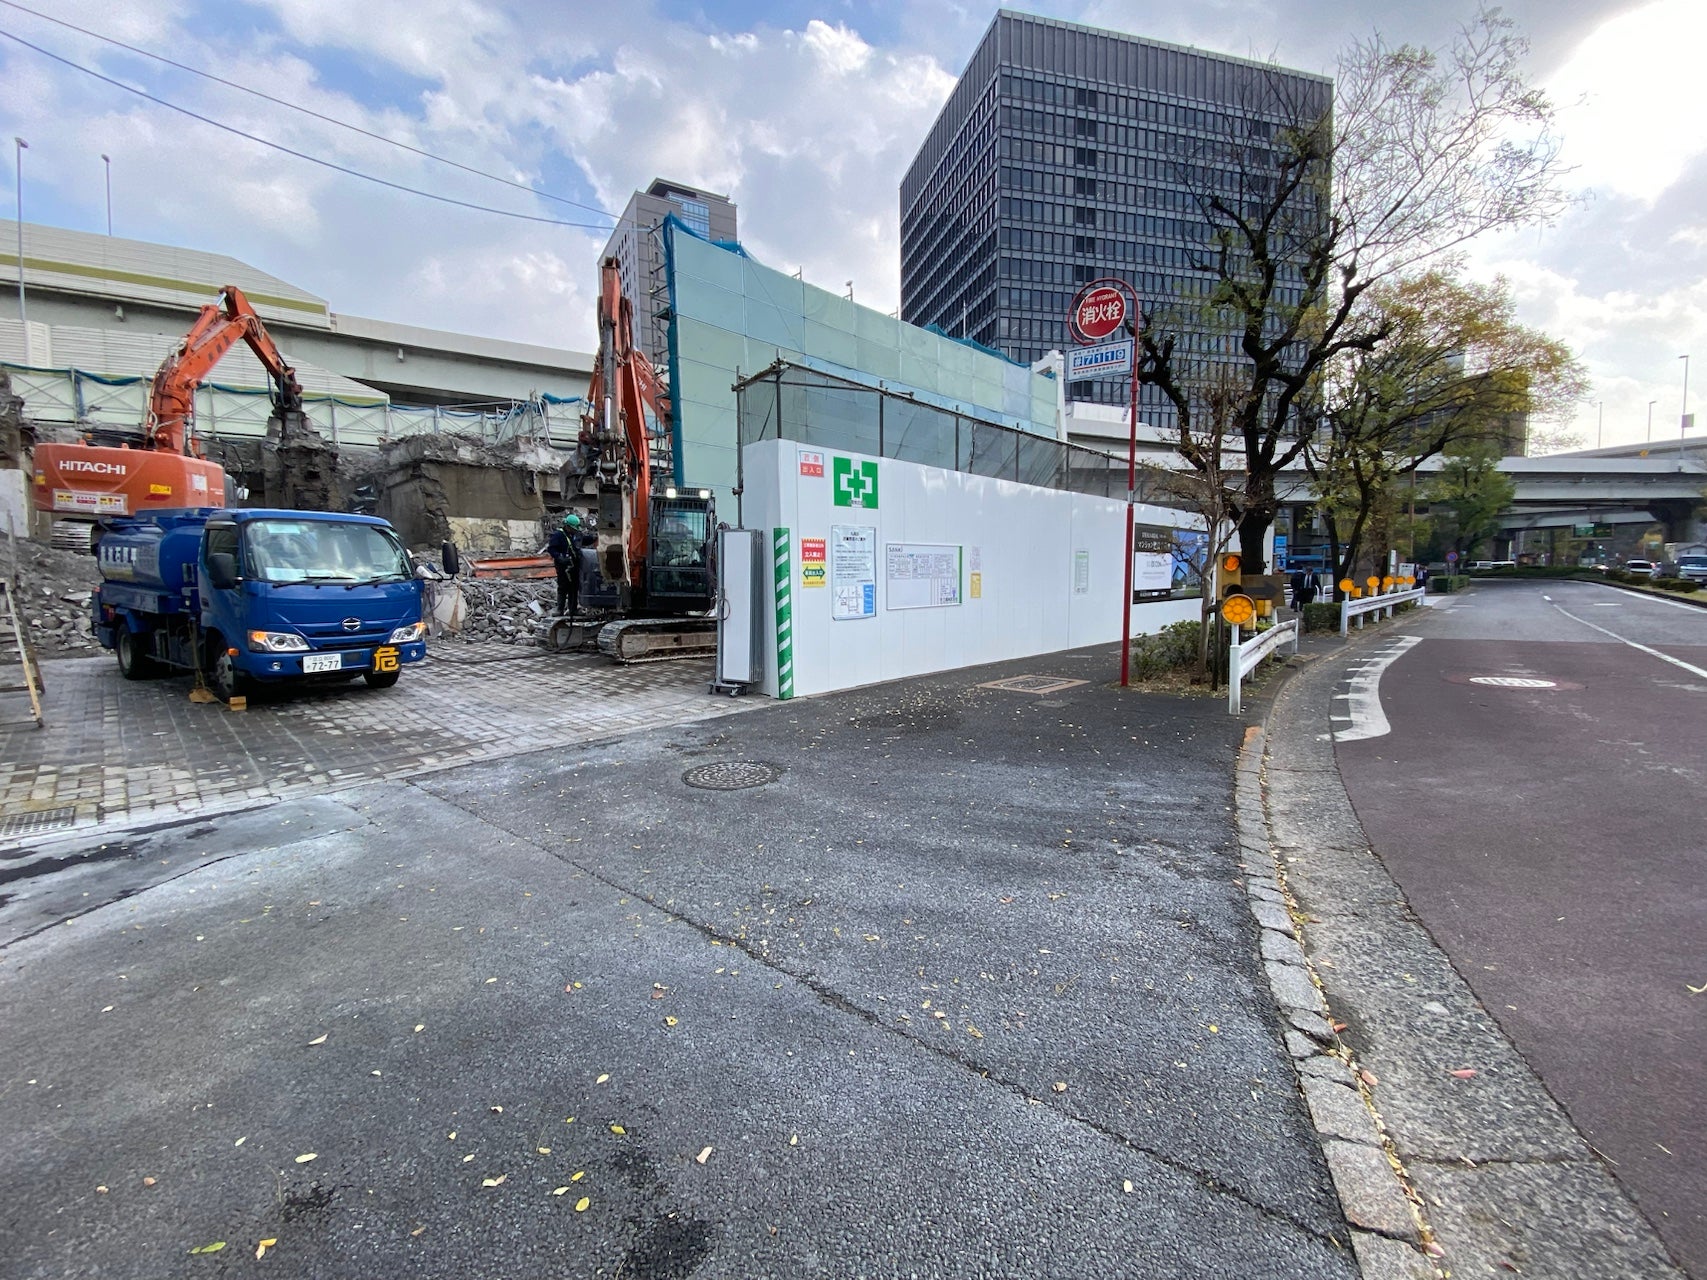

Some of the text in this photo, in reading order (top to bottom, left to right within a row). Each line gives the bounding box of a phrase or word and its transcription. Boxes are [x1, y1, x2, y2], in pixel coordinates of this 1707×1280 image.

[1082, 301, 1121, 325] 消火栓
[1074, 349, 1125, 367] #7119
[60, 460, 126, 475] HITACHI
[802, 465, 822, 474] 出入口
[312, 660, 339, 671] 72-77
[374, 646, 400, 671] 危
